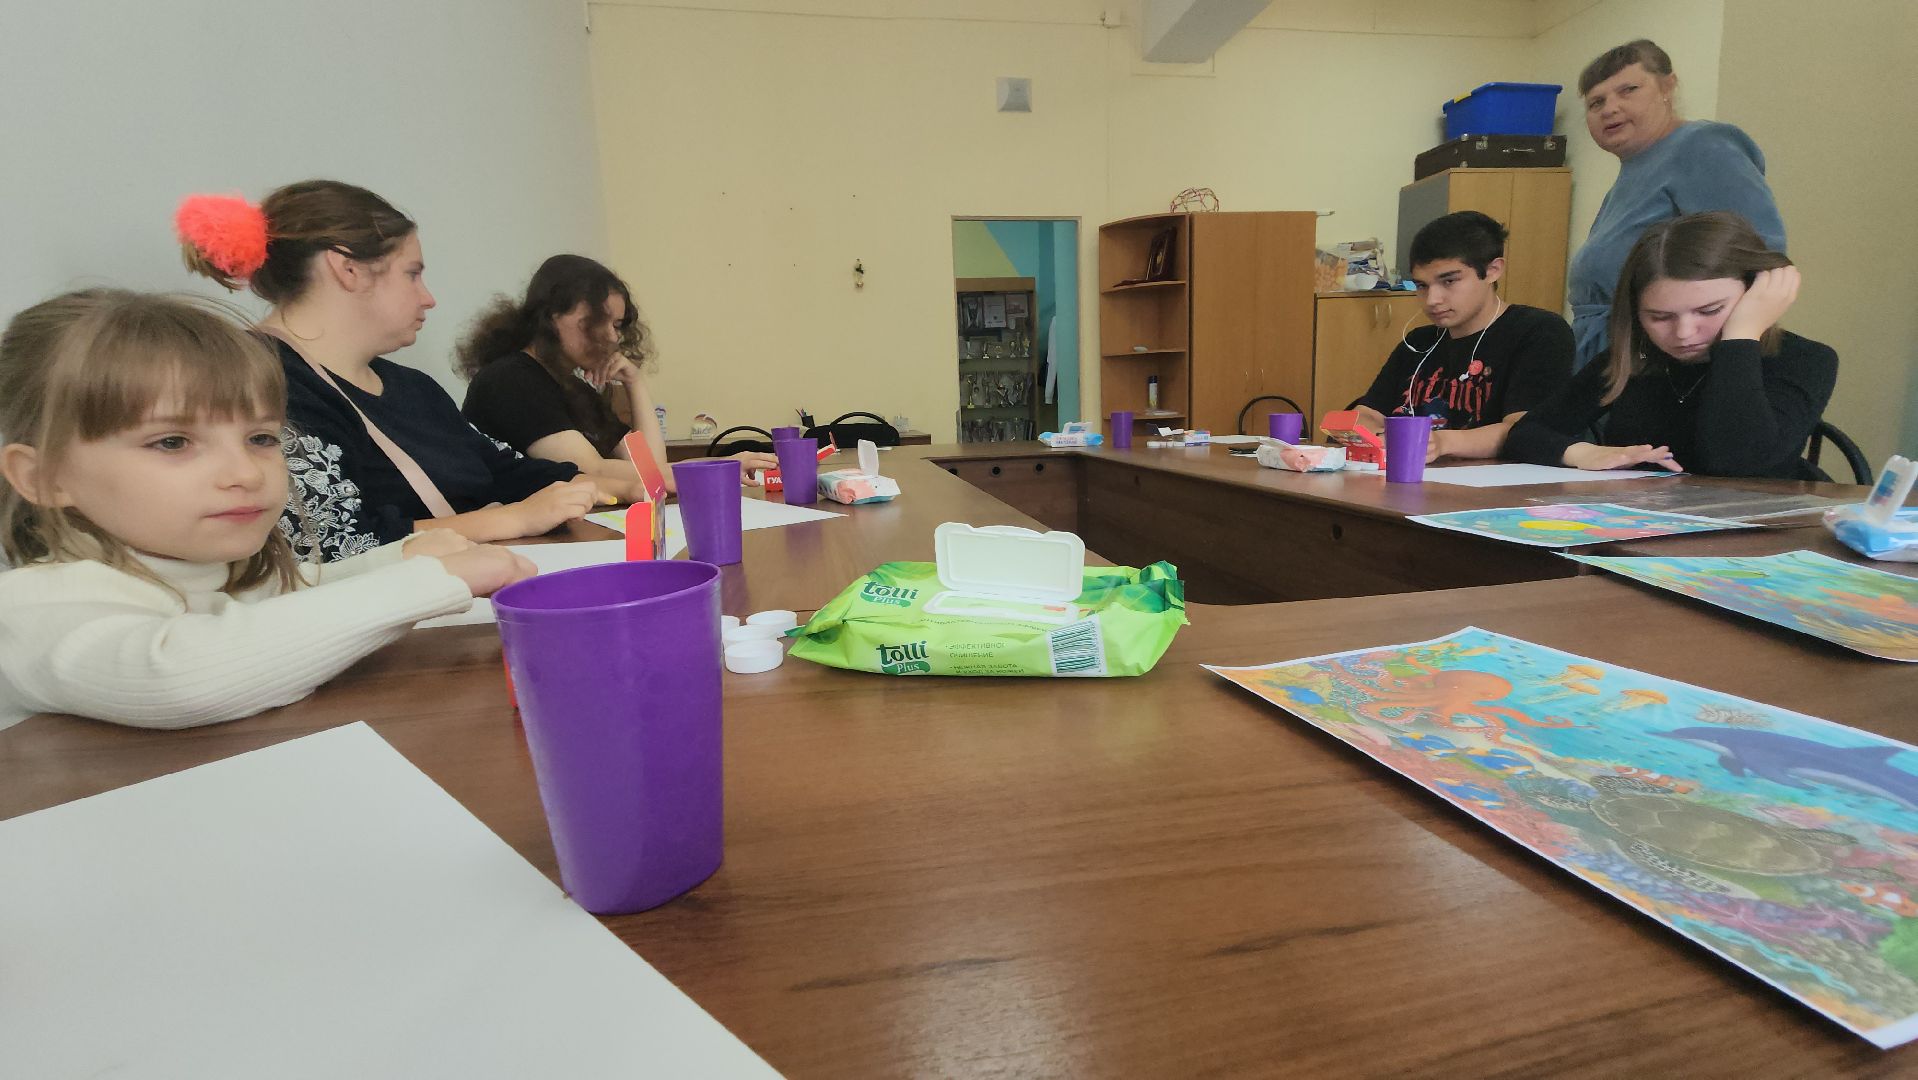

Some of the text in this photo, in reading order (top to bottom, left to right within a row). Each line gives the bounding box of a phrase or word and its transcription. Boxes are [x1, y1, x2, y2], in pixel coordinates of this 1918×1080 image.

[766, 476, 783, 484] ГУА
[864, 581, 919, 600] tolli
[873, 596, 901, 605] Plus
[876, 640, 929, 665] tolli
[896, 662, 920, 674] Plus
